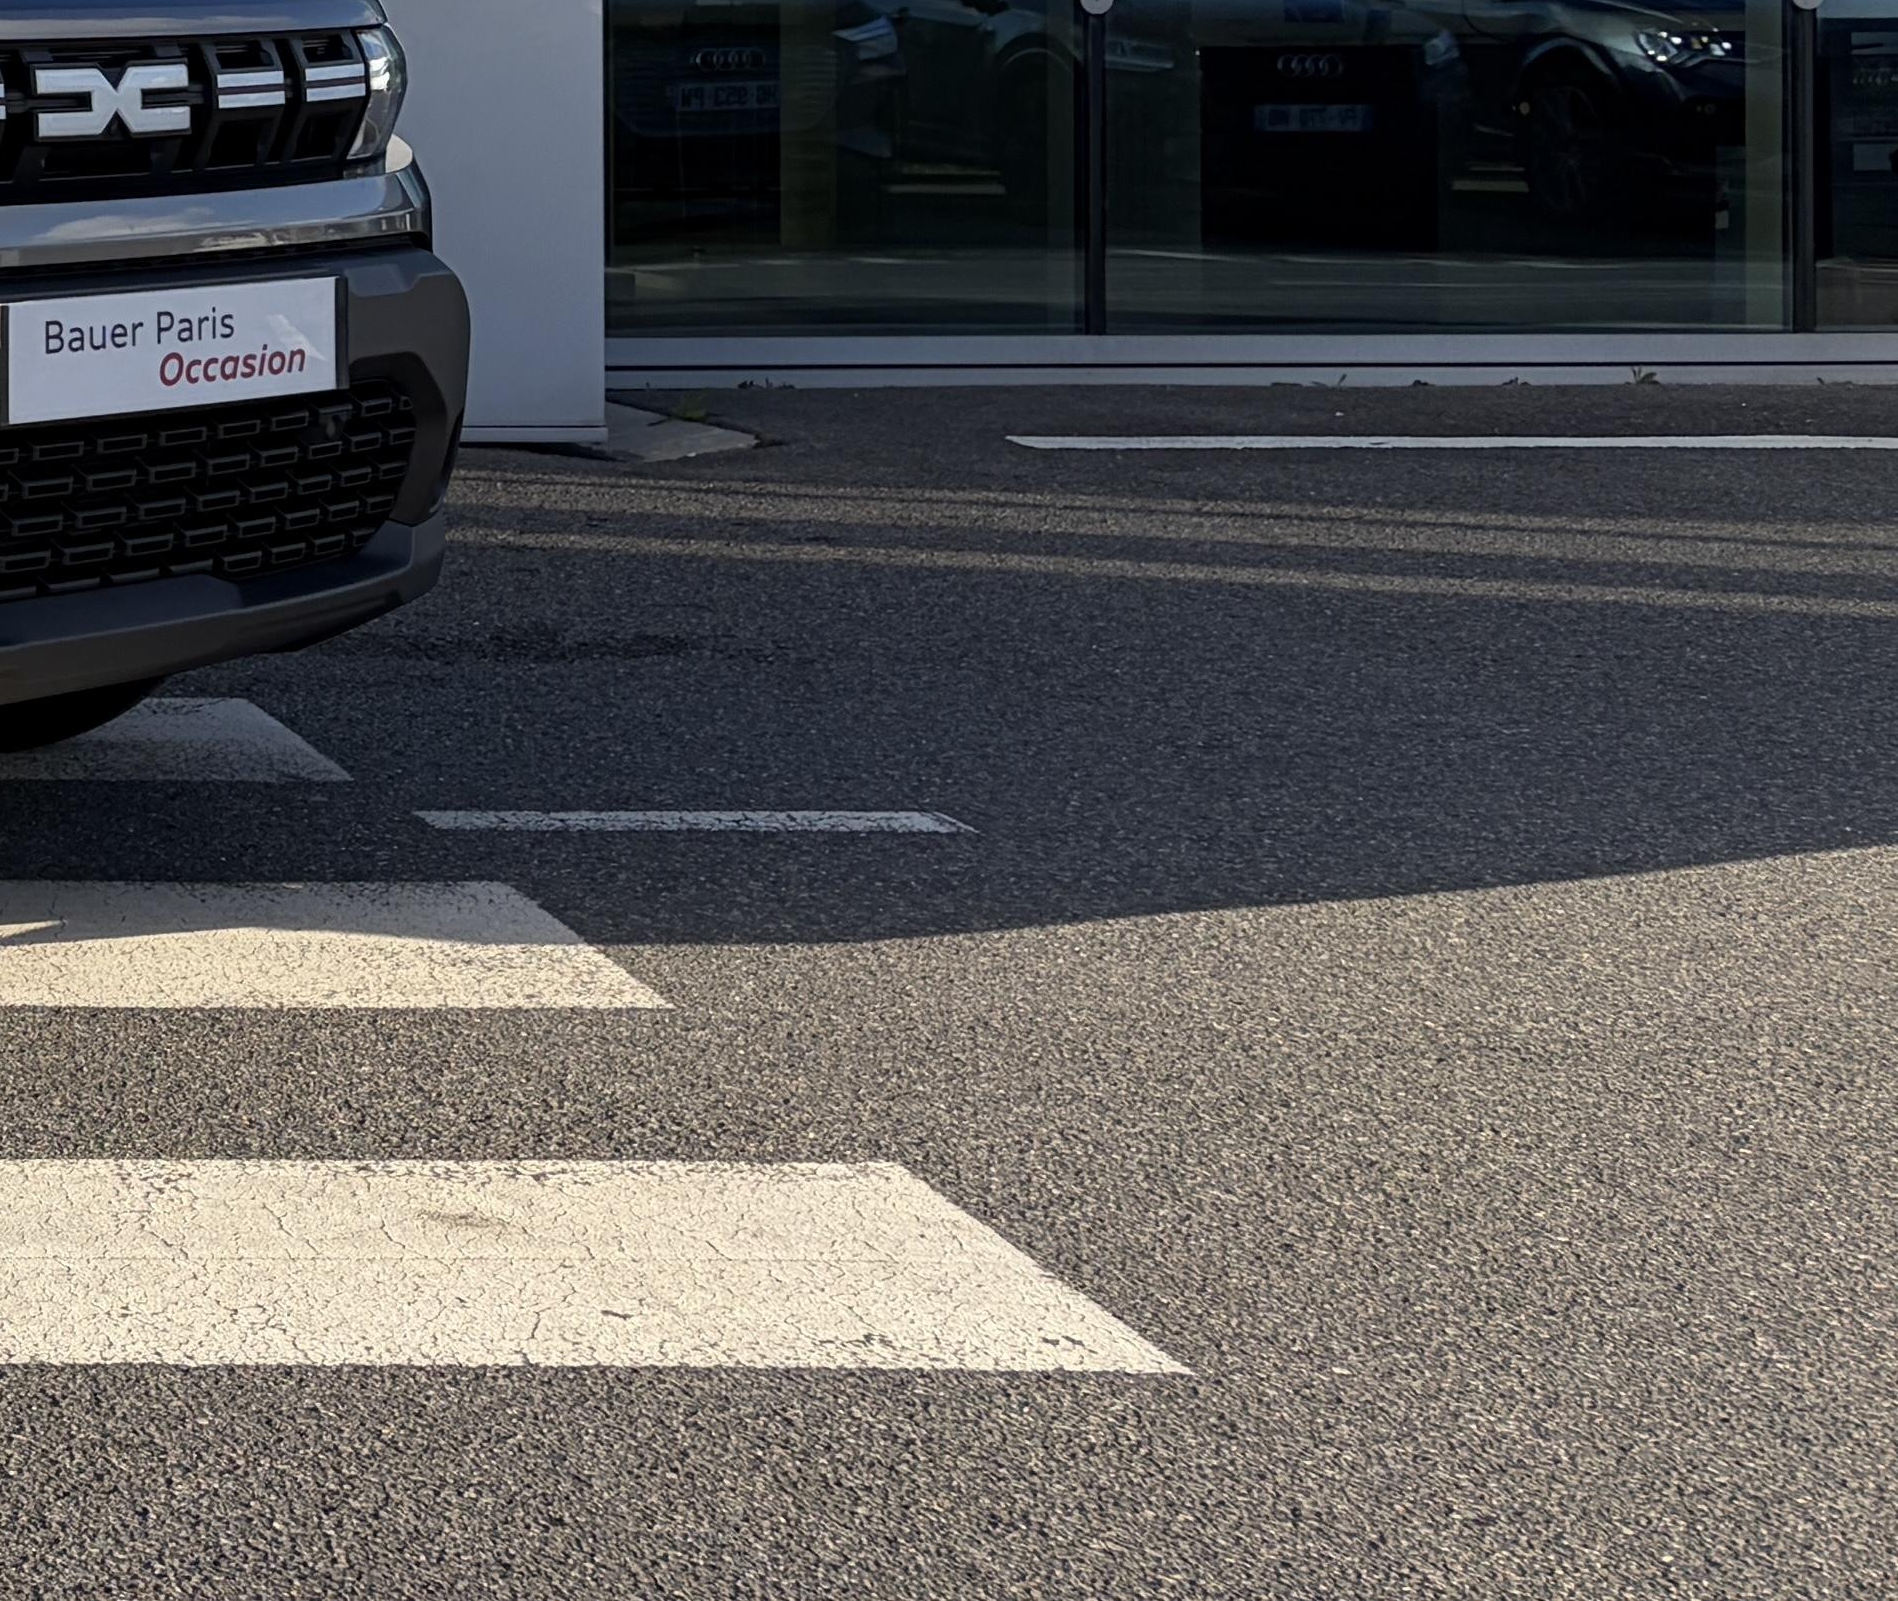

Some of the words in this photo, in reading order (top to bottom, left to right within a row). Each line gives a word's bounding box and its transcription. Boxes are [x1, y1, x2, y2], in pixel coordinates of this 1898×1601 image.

[44, 318, 145, 355] Bauer
[156, 306, 235, 345] Paris
[159, 343, 306, 387] Occasion
